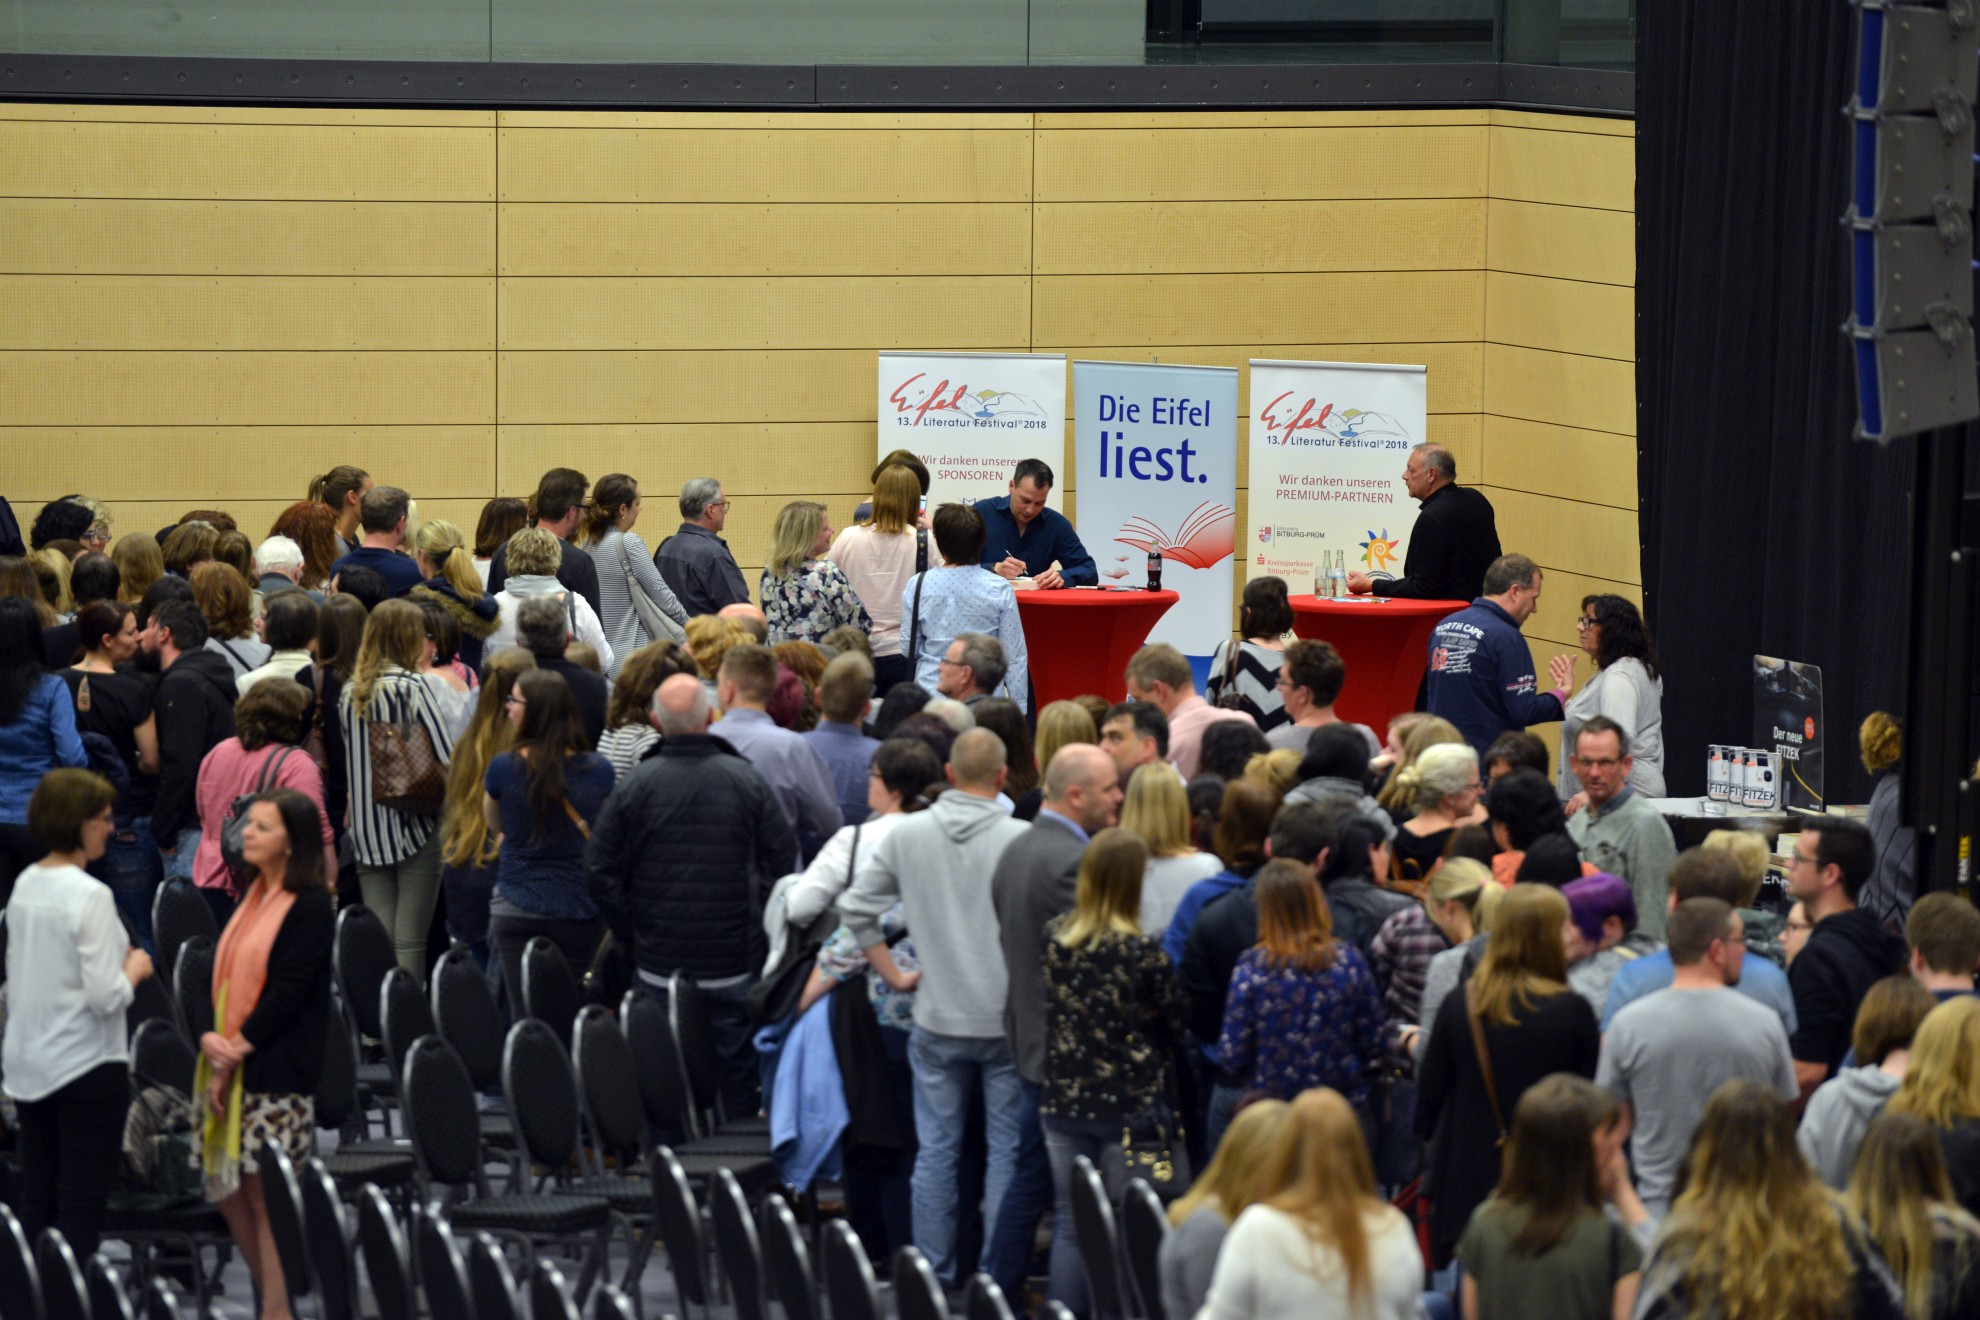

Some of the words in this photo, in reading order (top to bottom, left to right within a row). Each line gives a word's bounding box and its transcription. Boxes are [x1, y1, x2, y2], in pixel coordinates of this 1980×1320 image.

[890, 373, 968, 427] Eifel
[1099, 394, 1140, 423] Die
[1153, 397, 1210, 426] Eifel
[897, 417, 912, 426] 13.
[924, 417, 970, 427] Literatur
[1024, 420, 1047, 429] 2018
[1260, 391, 1333, 445] Eifel
[1266, 436, 1280, 445] 13.
[1291, 436, 1336, 446] Literatur
[1385, 440, 1408, 449] 2018
[919, 455, 937, 465] Wir
[940, 455, 978, 466] danken
[1099, 431, 1208, 484] liest.
[938, 470, 1003, 481] SPONSOREN
[1279, 474, 1298, 485] Wir
[1301, 475, 1343, 487] danken
[1347, 478, 1391, 489] unseren
[1276, 490, 1393, 504] PREMIUM-PARTNERN
[1276, 530, 1325, 538] BITBURG-PRÜM
[1267, 559, 1313, 568] Kreissparkasse
[1267, 568, 1309, 576] Bitburg-Prüm
[1436, 622, 1464, 634] NORTH
[1463, 624, 1485, 640] CAPE
[1773, 726, 1785, 740] Der
[1786, 732, 1803, 744] neue
[1775, 744, 1801, 761] FITZEK
[1743, 789, 1777, 801] FITZEK
